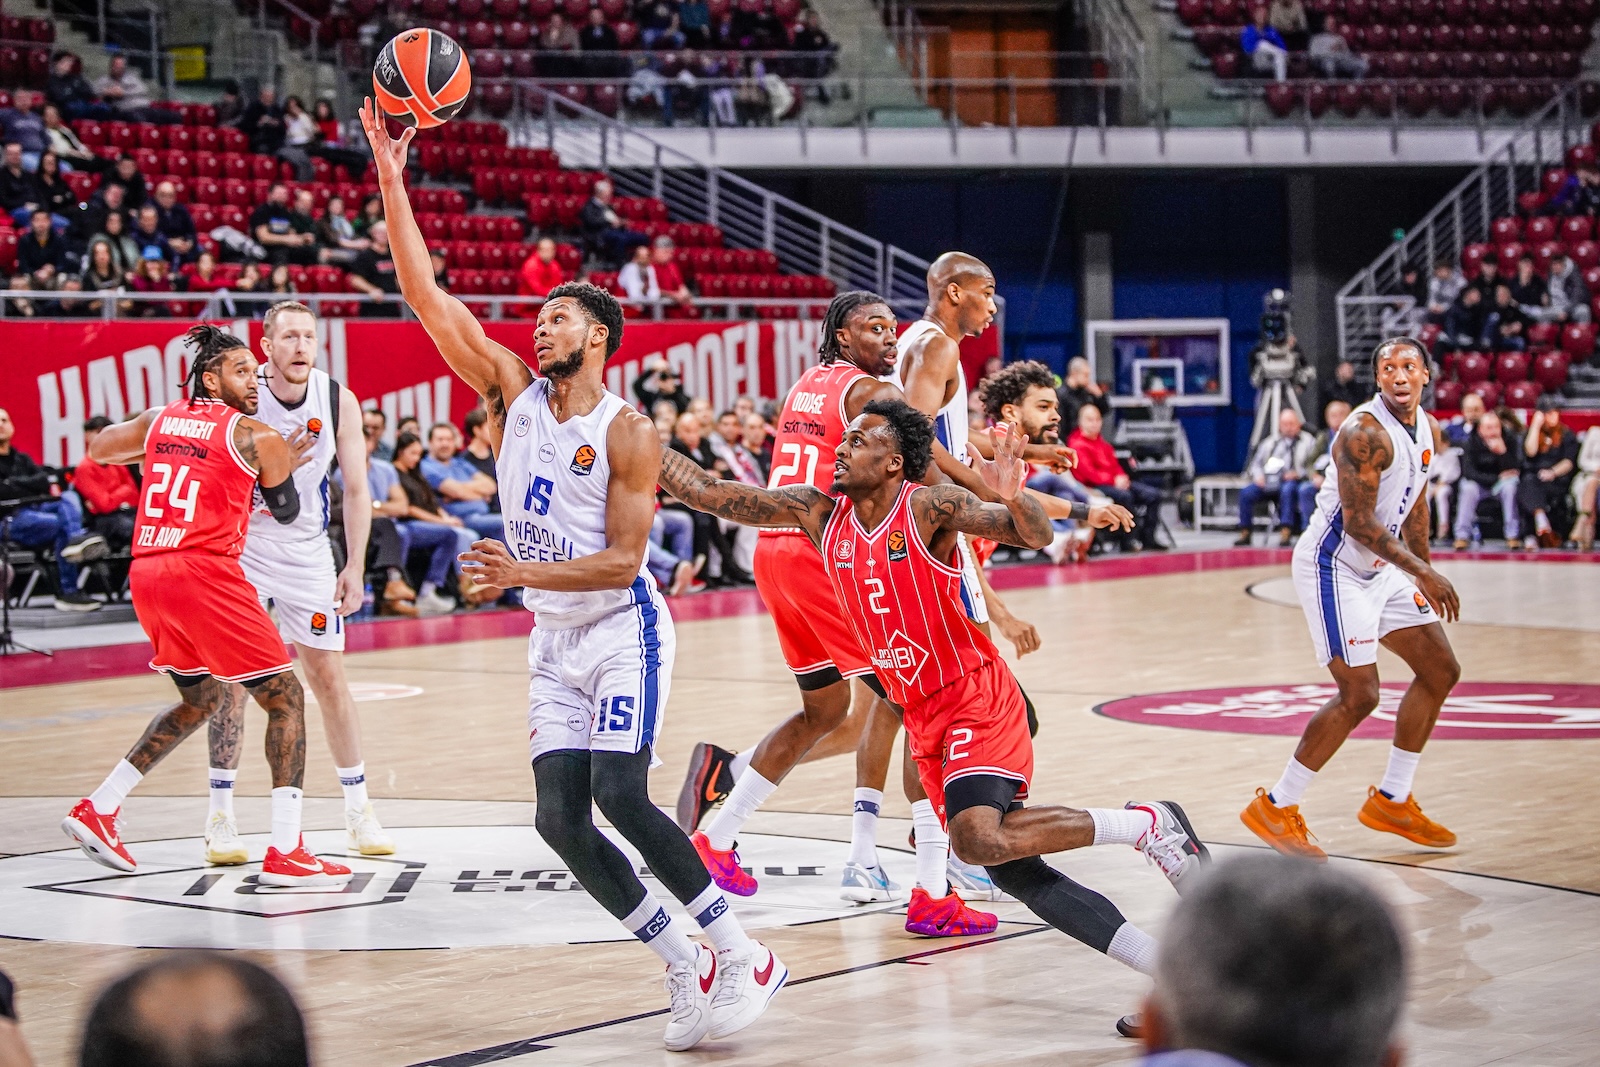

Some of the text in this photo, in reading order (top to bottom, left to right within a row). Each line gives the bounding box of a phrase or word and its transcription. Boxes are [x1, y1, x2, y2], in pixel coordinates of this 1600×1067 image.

[767, 442, 820, 490] 21
[144, 462, 201, 523] 24
[523, 471, 554, 516] 15
[136, 525, 187, 549] TEL AVIV
[509, 520, 574, 560] ANADOLU
[864, 577, 891, 615] 2
[890, 645, 917, 669] IBI
[597, 695, 635, 732] 15
[949, 727, 973, 761] 2
